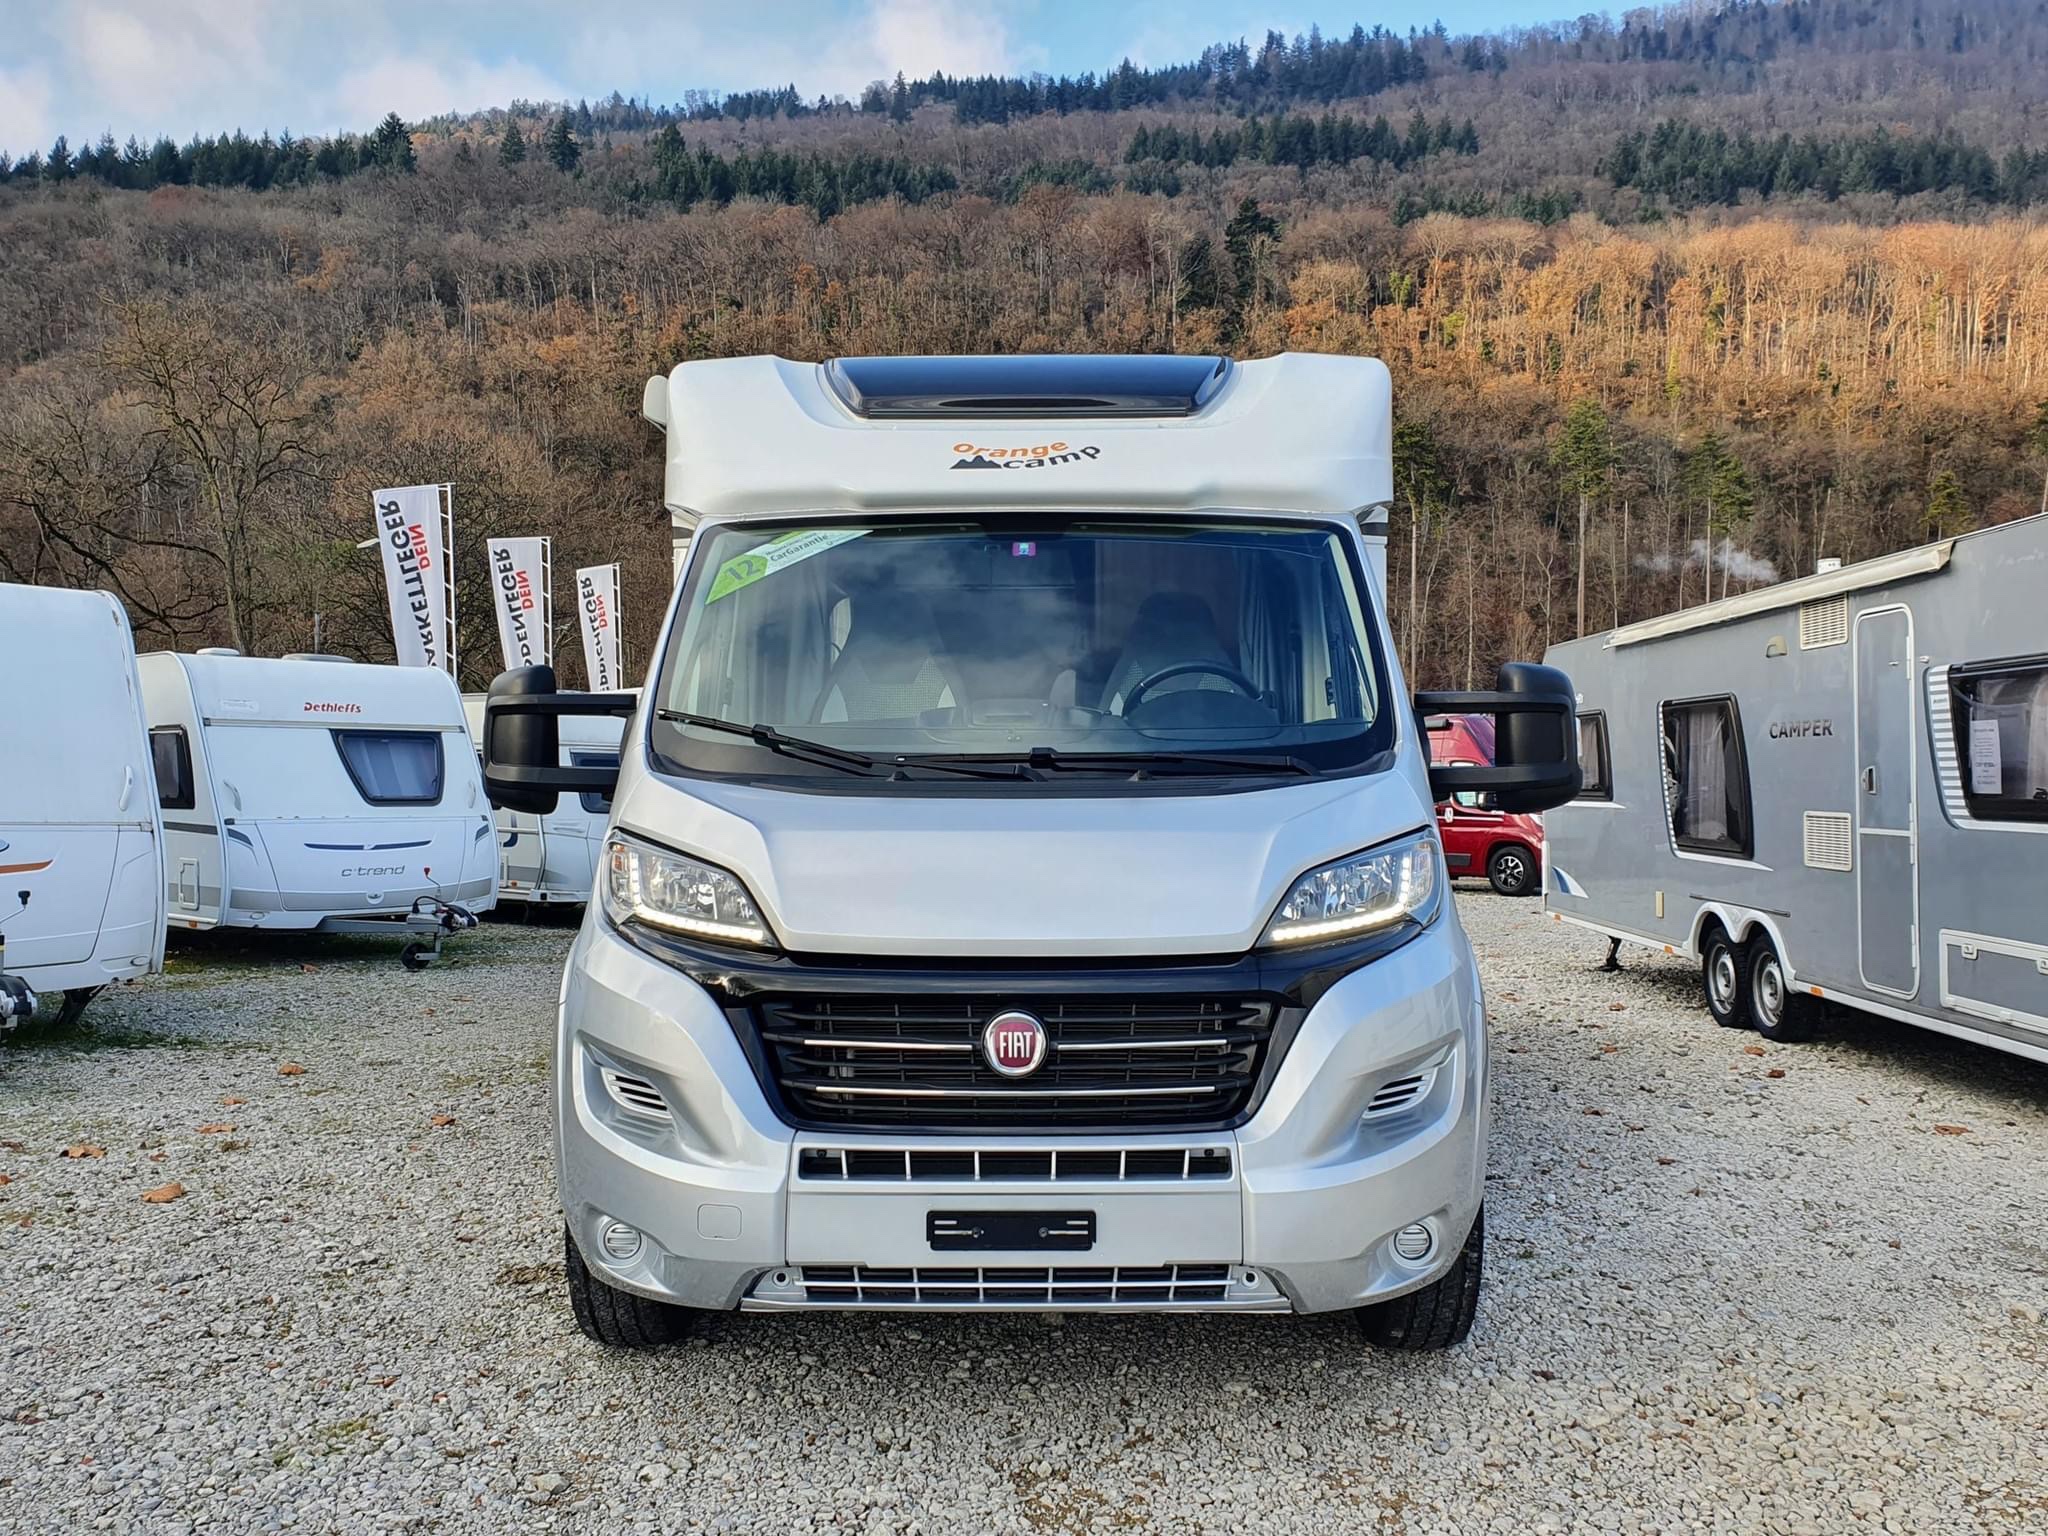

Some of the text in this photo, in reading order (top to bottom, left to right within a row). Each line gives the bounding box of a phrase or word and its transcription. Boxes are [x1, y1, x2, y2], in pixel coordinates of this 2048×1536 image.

[1003, 446, 1101, 469] camp
[725, 559, 761, 581] 12
[304, 702, 361, 713] Dethleffs
[1769, 719, 1833, 739] CAMPER
[999, 1031, 1033, 1058] FIAT
